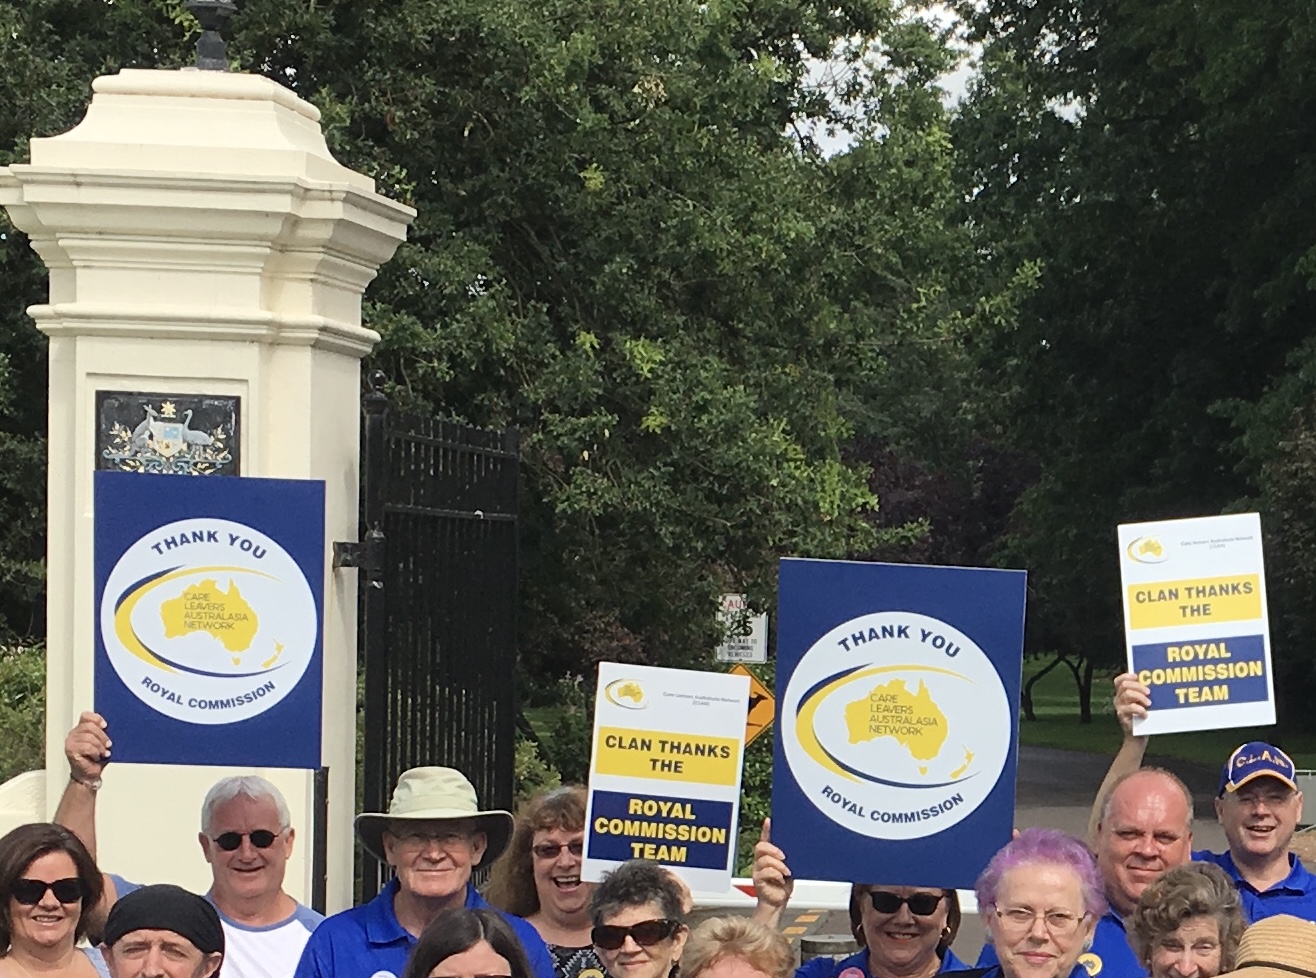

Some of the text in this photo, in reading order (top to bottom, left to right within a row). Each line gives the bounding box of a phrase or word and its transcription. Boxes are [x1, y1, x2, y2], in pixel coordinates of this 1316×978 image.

[151, 530, 267, 559] THANK YOU
[184, 593, 210, 601] CARE
[1136, 581, 1253, 604] CLAN THANKS
[184, 603, 225, 611] LEAVERS
[184, 612, 249, 621] AUSTRALASIA
[1179, 603, 1212, 618] THE
[184, 621, 235, 630] NETWORK
[838, 625, 961, 658] THANK YOU
[1167, 643, 1231, 663] ROYAL
[1139, 660, 1263, 686] COMMISSION
[141, 676, 276, 710] ROYAL COMMISSION
[870, 694, 898, 703] CARE
[1175, 685, 1229, 704] TEAM
[870, 704, 914, 714] LEAVERS
[869, 714, 938, 726] AUSTRALASIA
[869, 725, 923, 736] NETWORK
[605, 735, 731, 759] CLAN THANKS
[650, 758, 684, 774] THE
[628, 799, 696, 820] ROYAL
[821, 785, 964, 824] ROYAL COMMISSION
[594, 817, 727, 844] COMMISSION
[631, 843, 687, 863] TEAM
